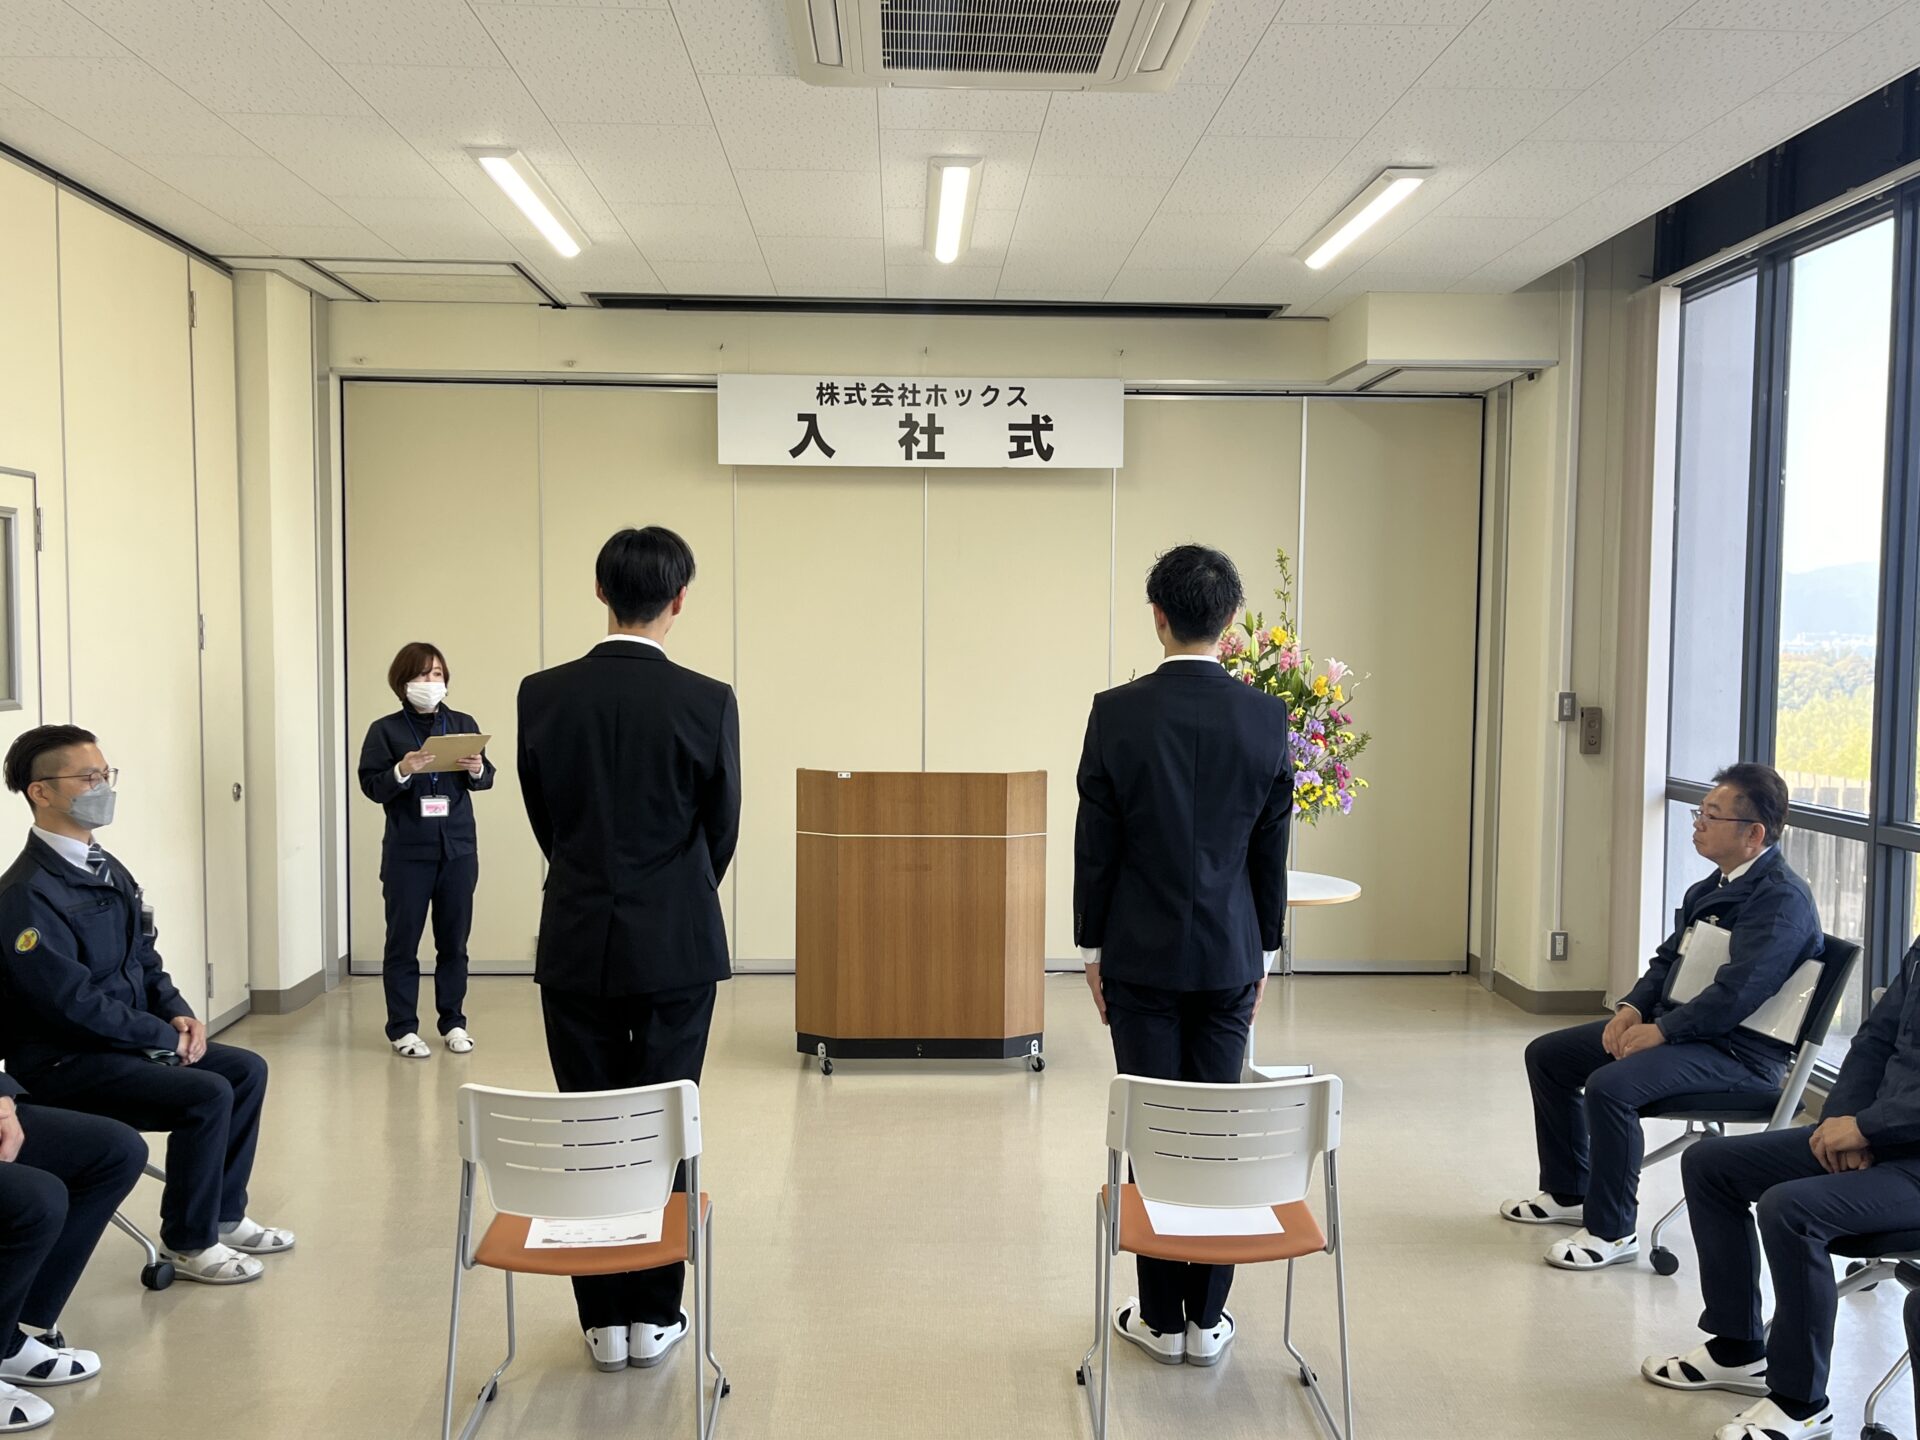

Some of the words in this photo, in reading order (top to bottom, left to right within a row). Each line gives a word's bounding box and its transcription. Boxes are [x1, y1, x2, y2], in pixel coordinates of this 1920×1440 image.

[816, 381, 1028, 408] 株式会社ホックス
